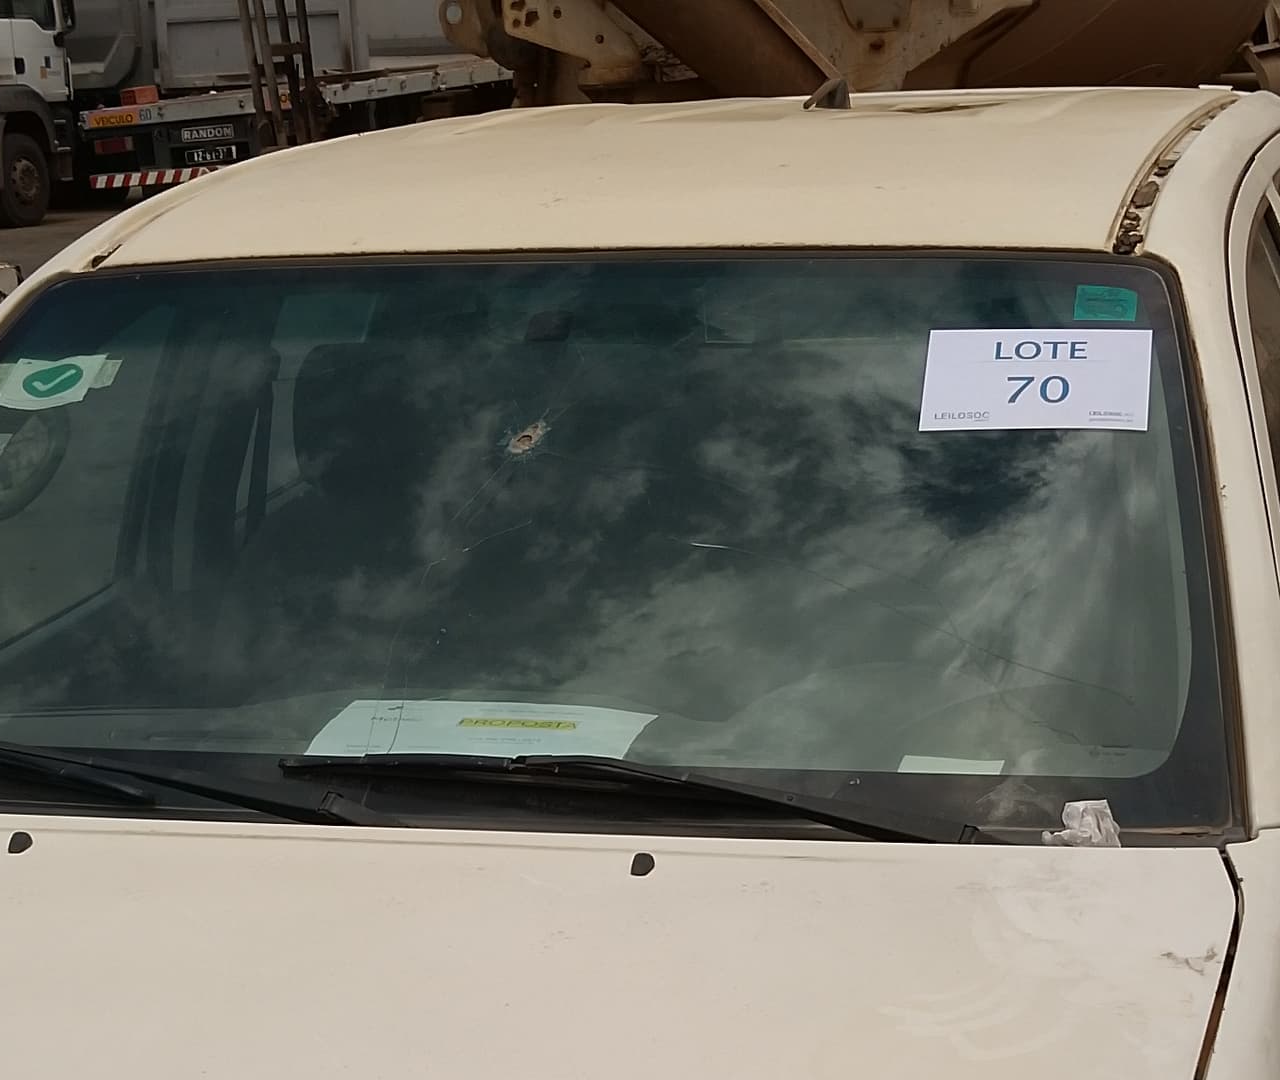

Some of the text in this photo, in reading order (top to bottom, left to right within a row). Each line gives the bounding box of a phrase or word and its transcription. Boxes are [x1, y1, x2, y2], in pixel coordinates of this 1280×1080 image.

[994, 341, 1088, 360] LOTE
[1007, 376, 1070, 404] 70
[458, 718, 580, 729] PROPOSTA
